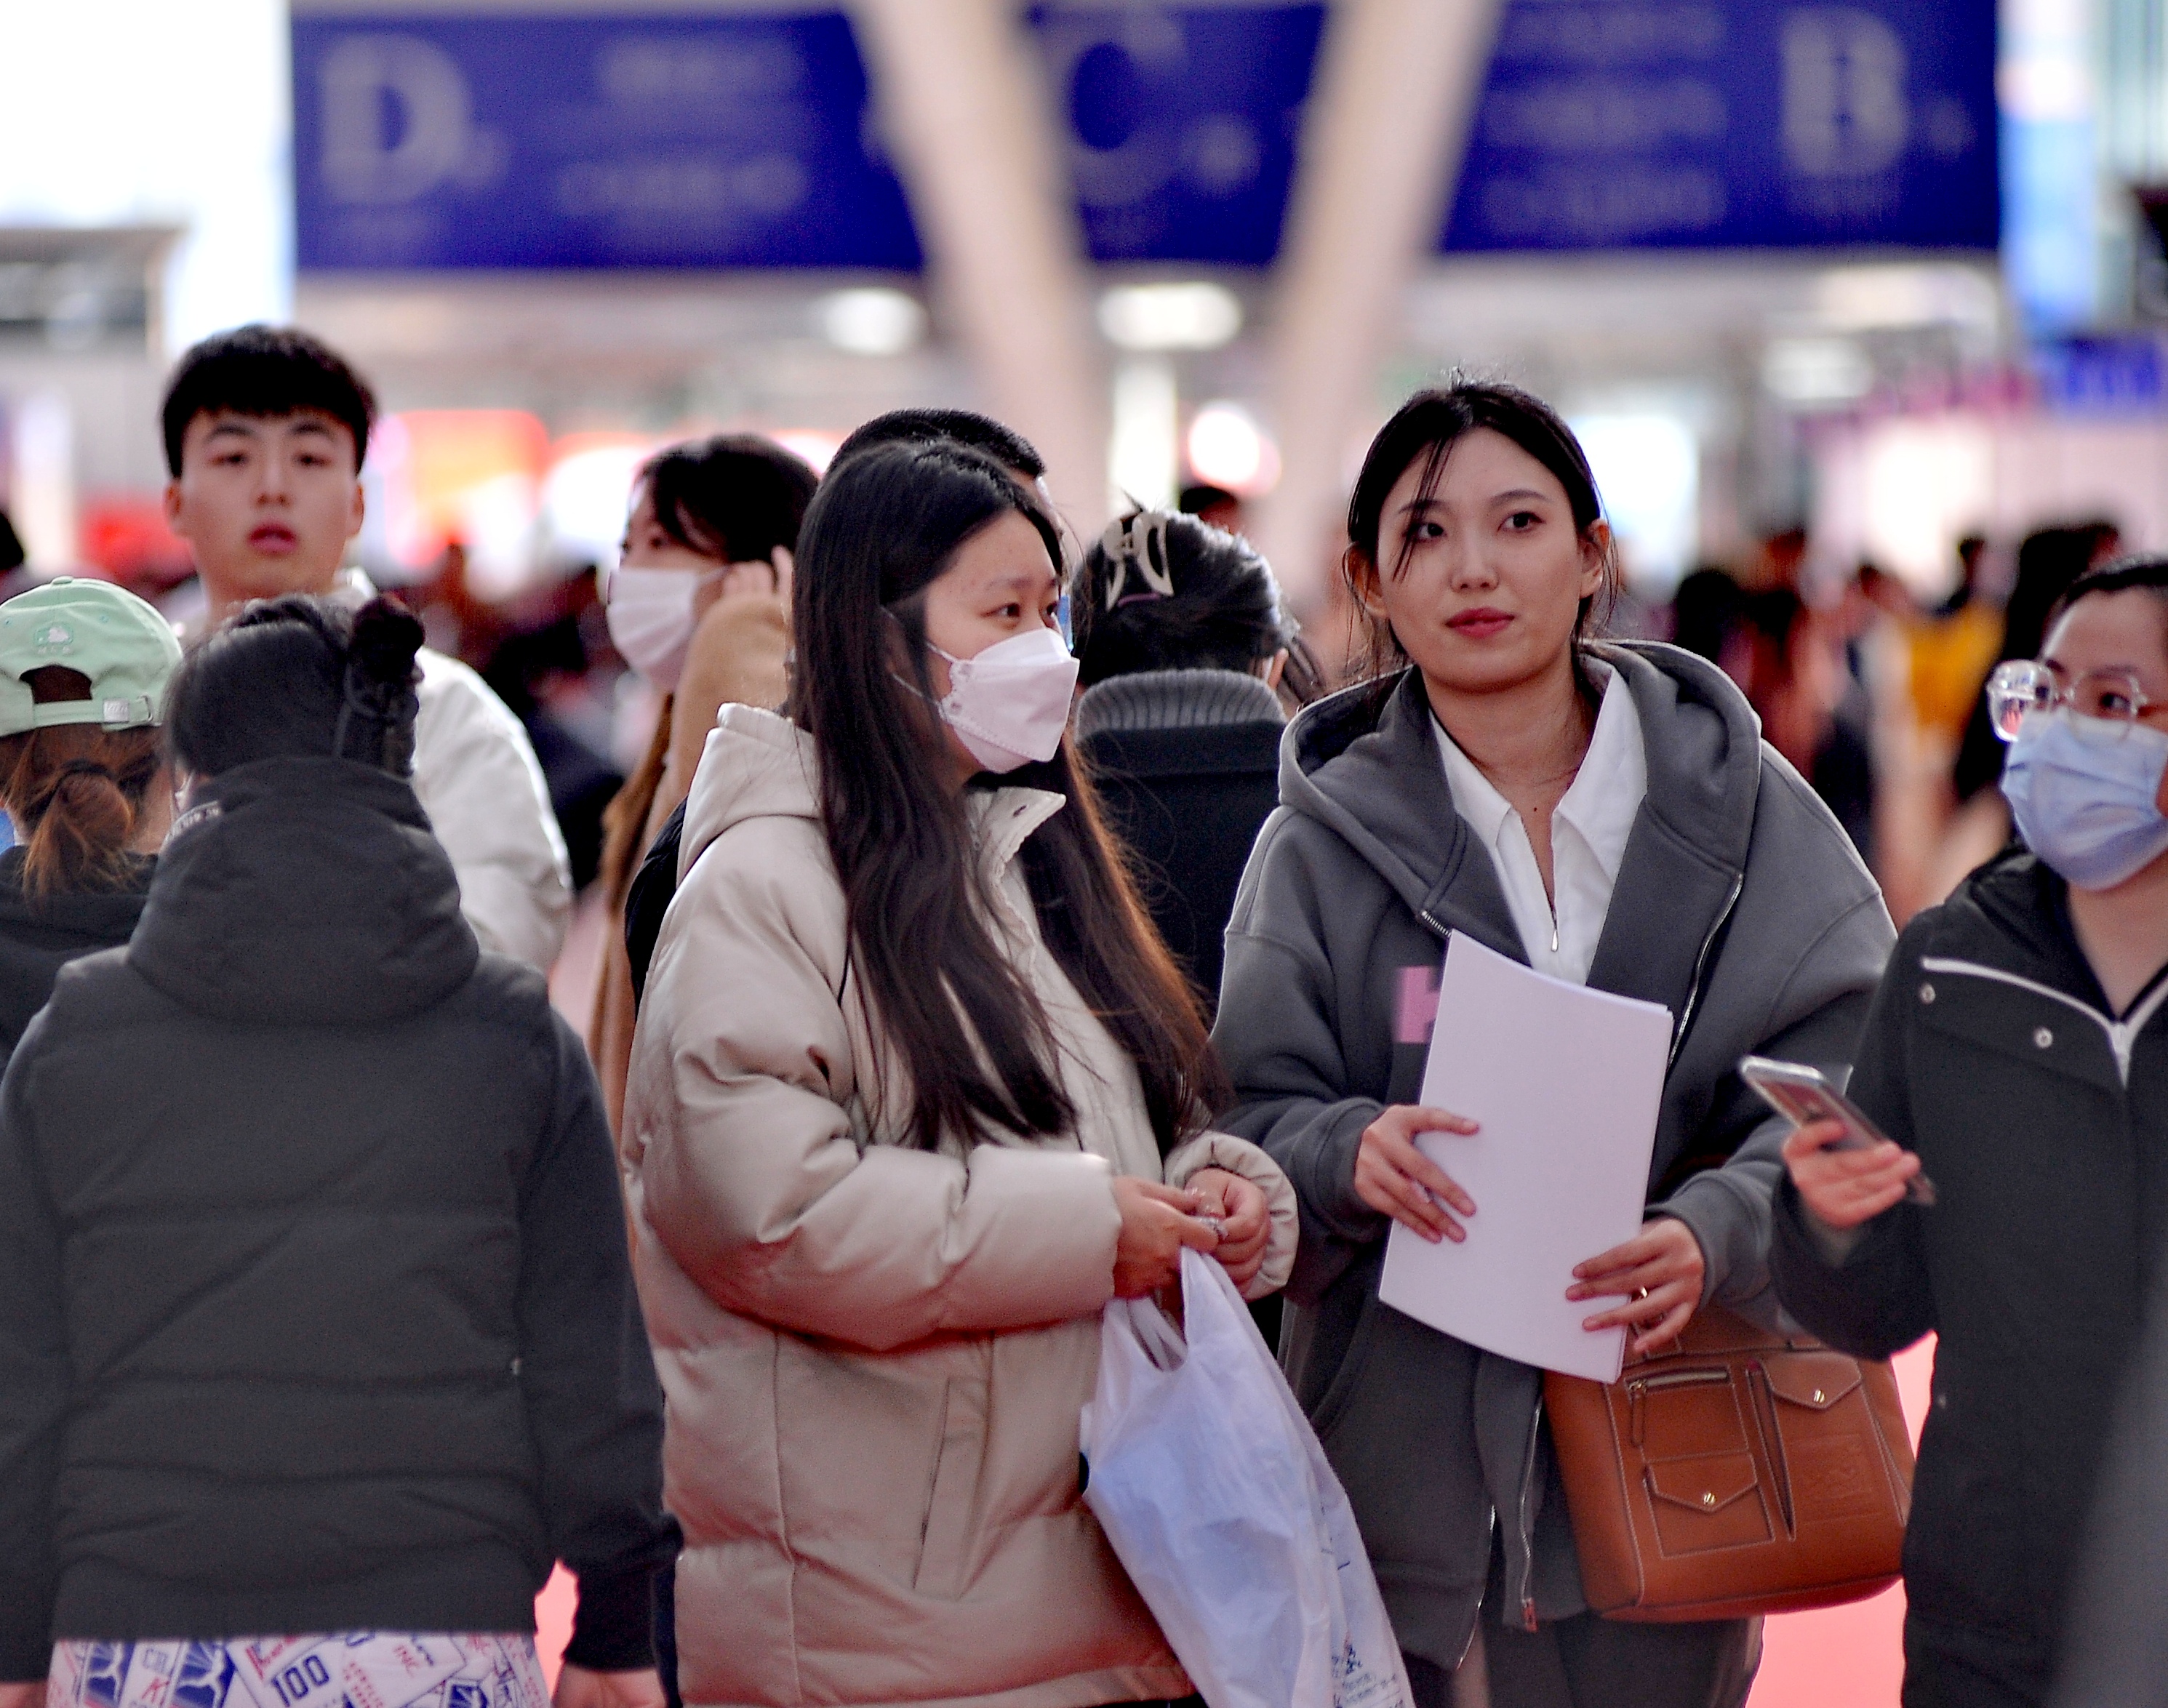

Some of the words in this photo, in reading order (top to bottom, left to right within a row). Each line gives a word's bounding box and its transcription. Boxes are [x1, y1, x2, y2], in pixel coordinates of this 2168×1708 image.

[322, 33, 471, 205] D
[1781, 7, 1911, 178] B
[271, 1654, 330, 1708] 100
